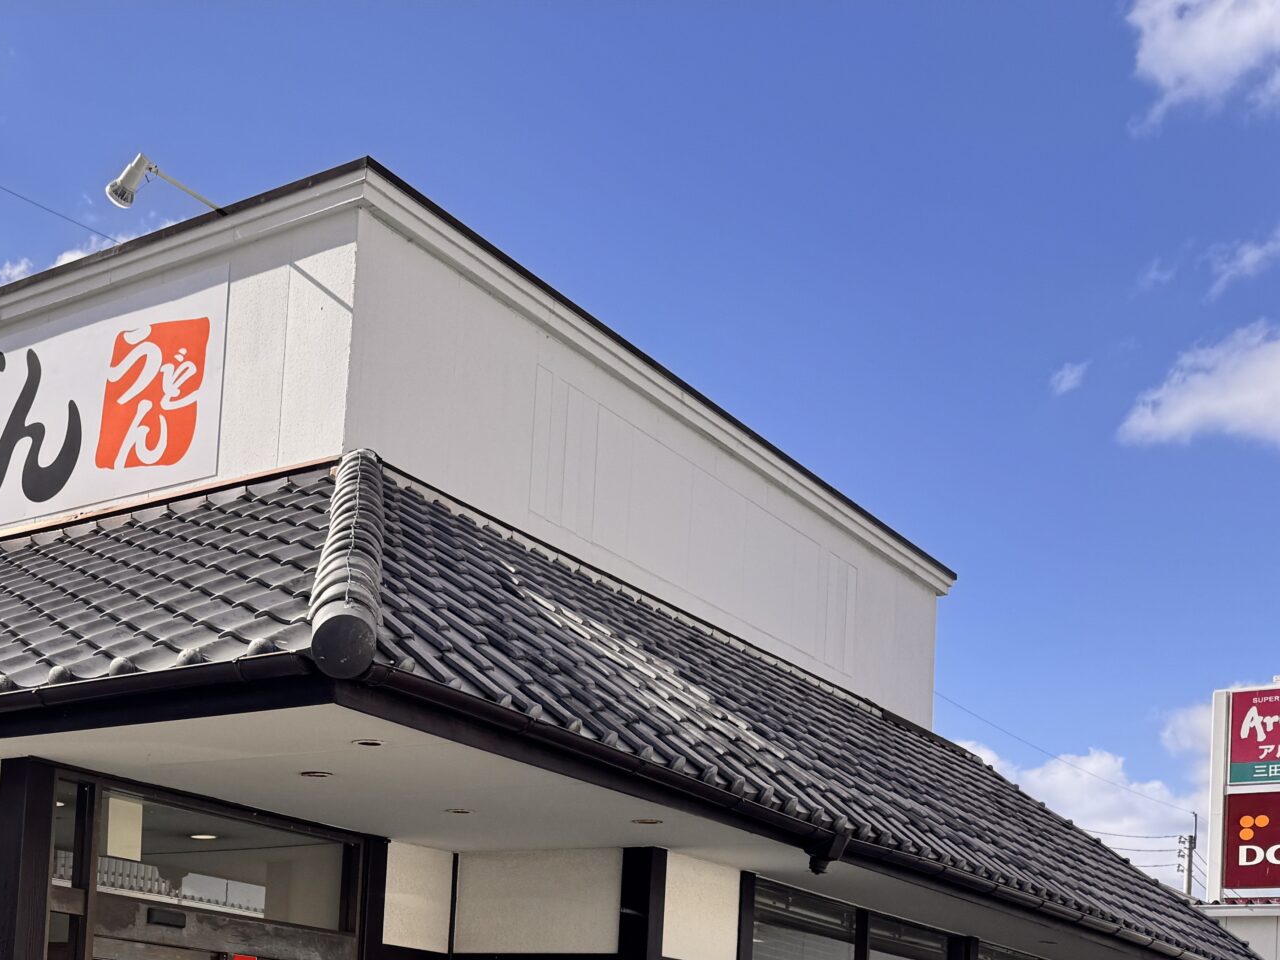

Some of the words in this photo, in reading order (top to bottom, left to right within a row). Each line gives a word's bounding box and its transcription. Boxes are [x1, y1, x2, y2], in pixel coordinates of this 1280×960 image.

[106, 325, 202, 469] うどん
[1252, 696, 1280, 704] SUPER
[1240, 705, 1280, 742] Ar
